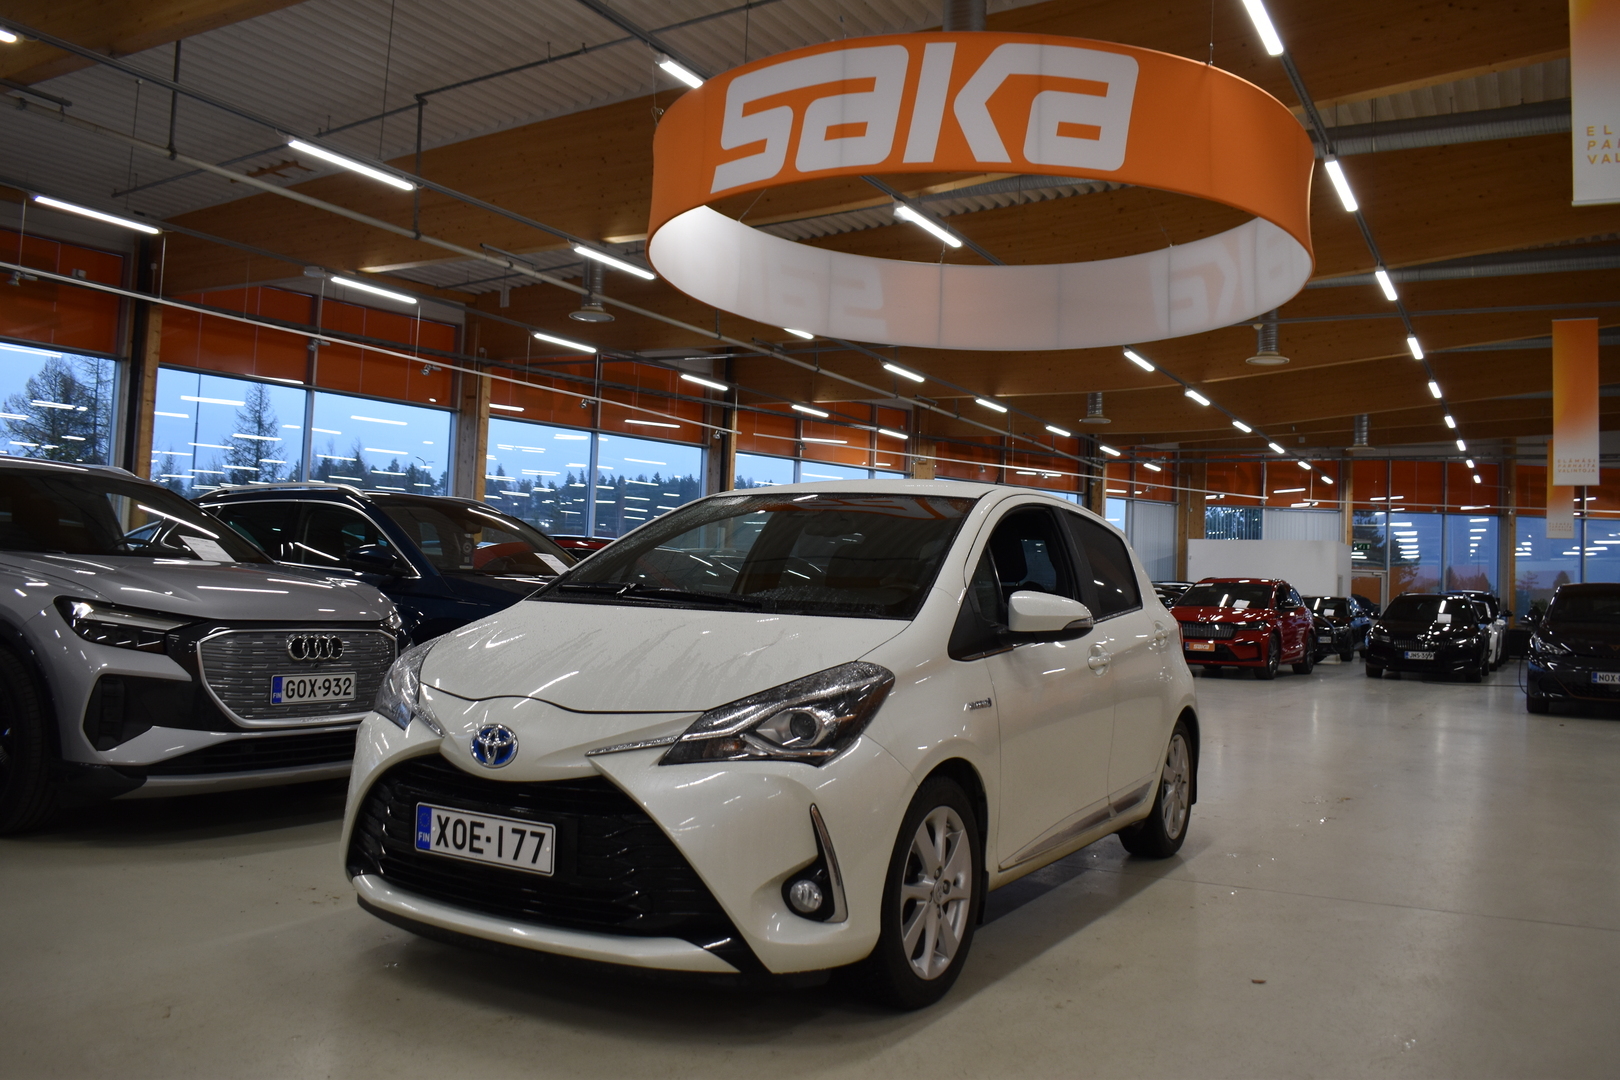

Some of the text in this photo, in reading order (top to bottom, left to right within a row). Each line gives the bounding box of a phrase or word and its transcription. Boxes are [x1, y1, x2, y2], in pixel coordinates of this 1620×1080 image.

[1587, 138, 1620, 150] PA
[285, 677, 352, 699] GOX-932
[418, 831, 430, 843] FIN
[435, 814, 546, 865] XOE-177
